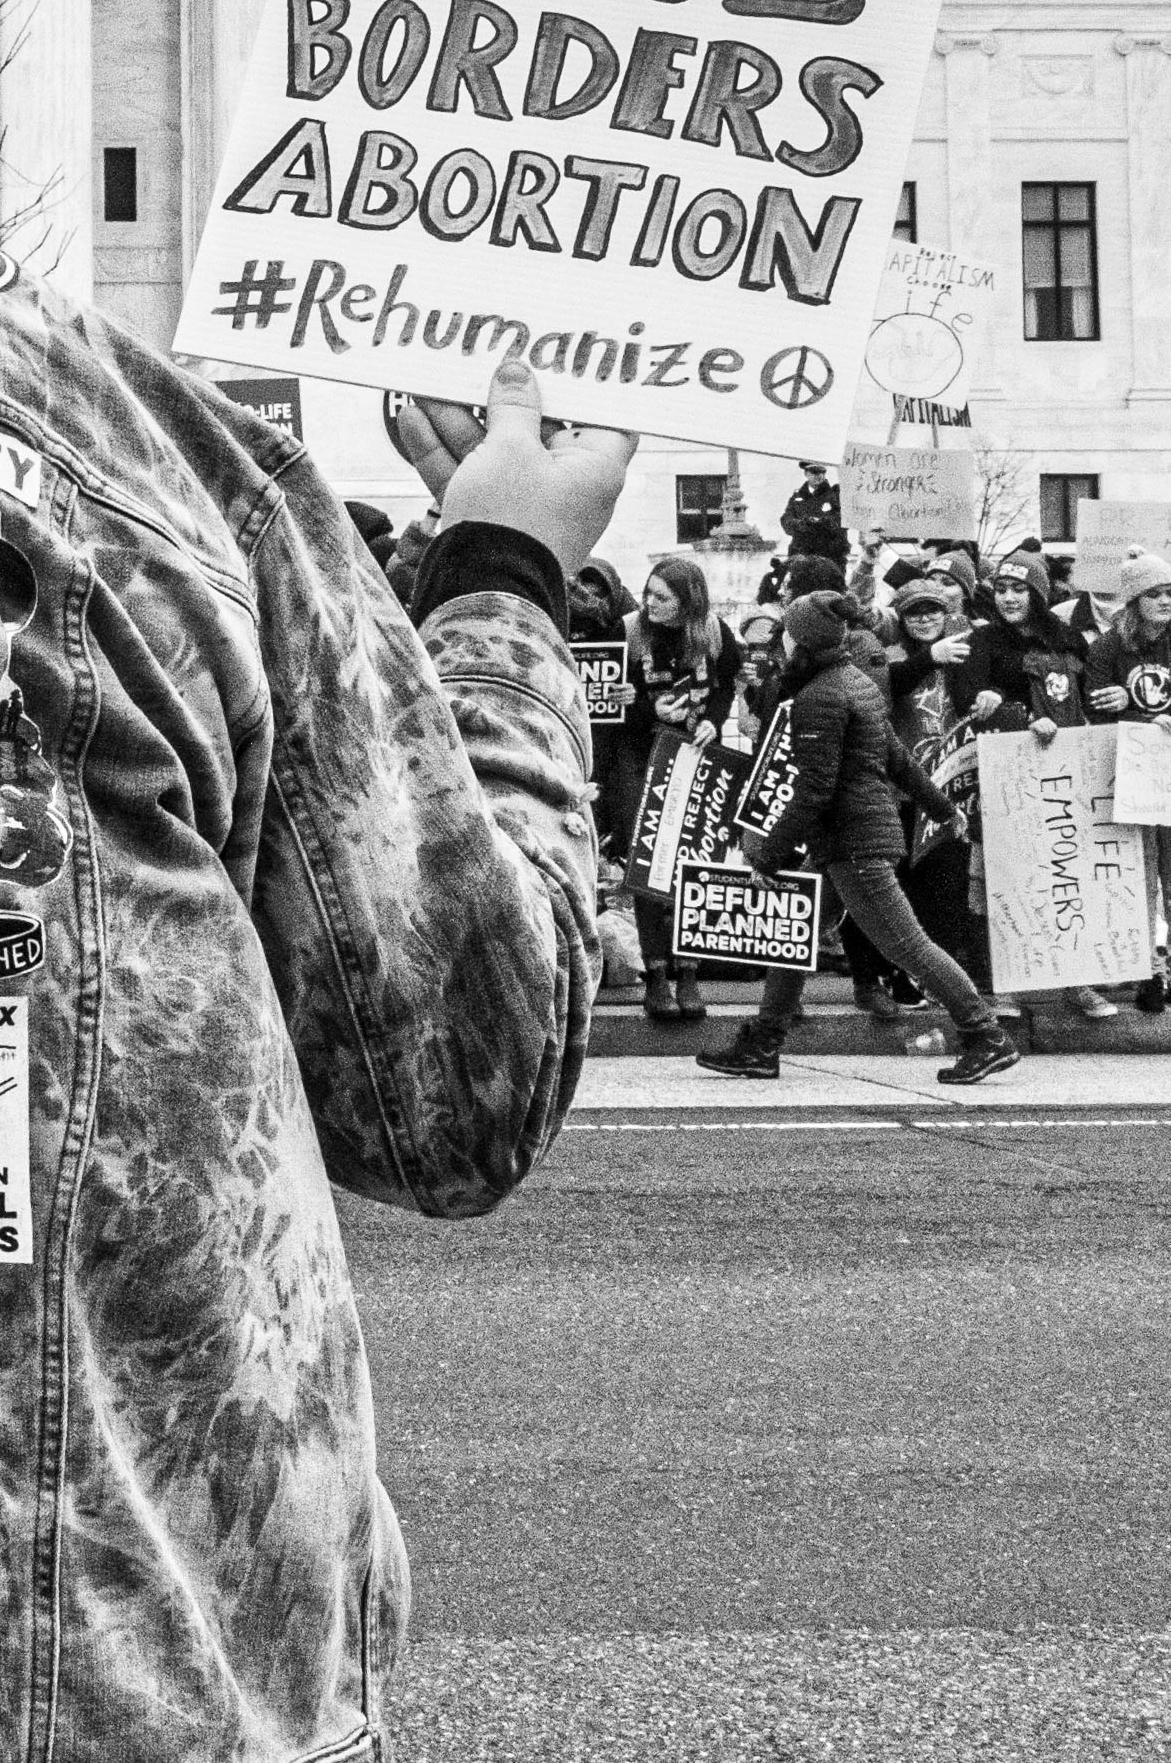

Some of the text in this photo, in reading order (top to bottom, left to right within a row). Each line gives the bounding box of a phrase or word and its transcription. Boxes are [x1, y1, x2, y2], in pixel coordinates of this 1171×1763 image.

[222, 118, 861, 305] ABORTION
[887, 252, 995, 291] APITALISM
[211, 258, 745, 390] #Rehumanize
[683, 756, 714, 830] REJECT
[690, 767, 735, 864] bortion
[758, 768, 780, 806] AM
[641, 809, 661, 852] AM
[1040, 774, 1086, 933] EMPOWERS
[1090, 794, 1122, 881] LIFE
[682, 907, 811, 943] PLANNED
[684, 881, 813, 920] DEFUND
[681, 930, 810, 961] PARENTHOOD
